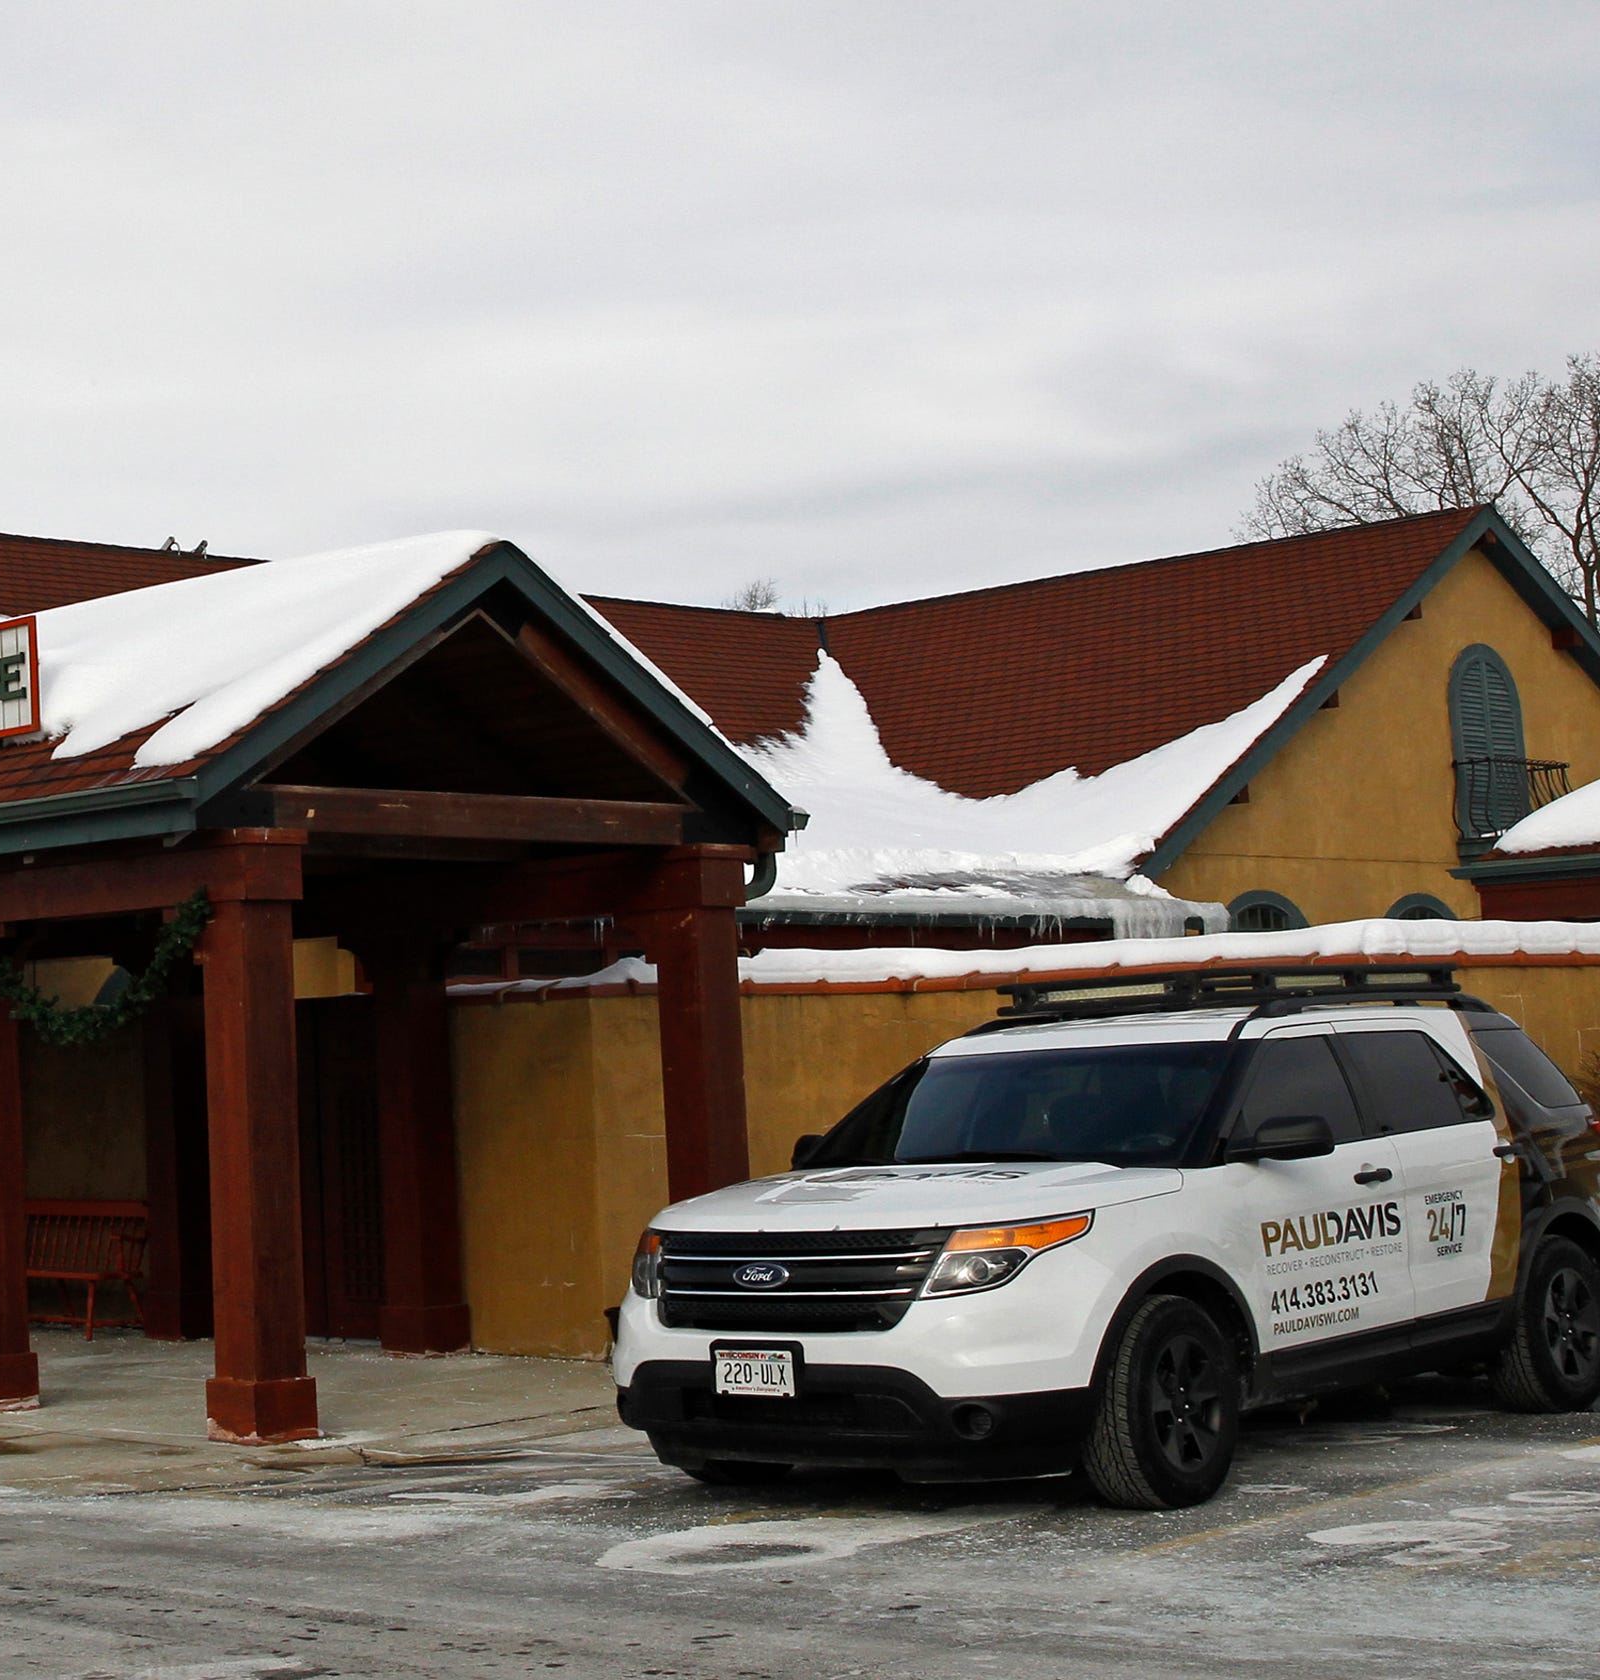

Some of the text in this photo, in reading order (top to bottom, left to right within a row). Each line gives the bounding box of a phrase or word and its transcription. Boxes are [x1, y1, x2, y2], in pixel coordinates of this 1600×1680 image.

[1424, 1190, 1463, 1205] EMERGENCY
[1427, 1202, 1466, 1242] 24/7
[1266, 1242, 1403, 1275] RECOVER RECONSTRUCT RESTORE
[1437, 1243, 1462, 1257] SERVICE
[742, 1266, 774, 1281] Ford
[1271, 1270, 1379, 1314] 414.383.3131
[1273, 1307, 1360, 1336] PAULDAVISWI.COM
[723, 1362, 787, 1386] 220-ULX
